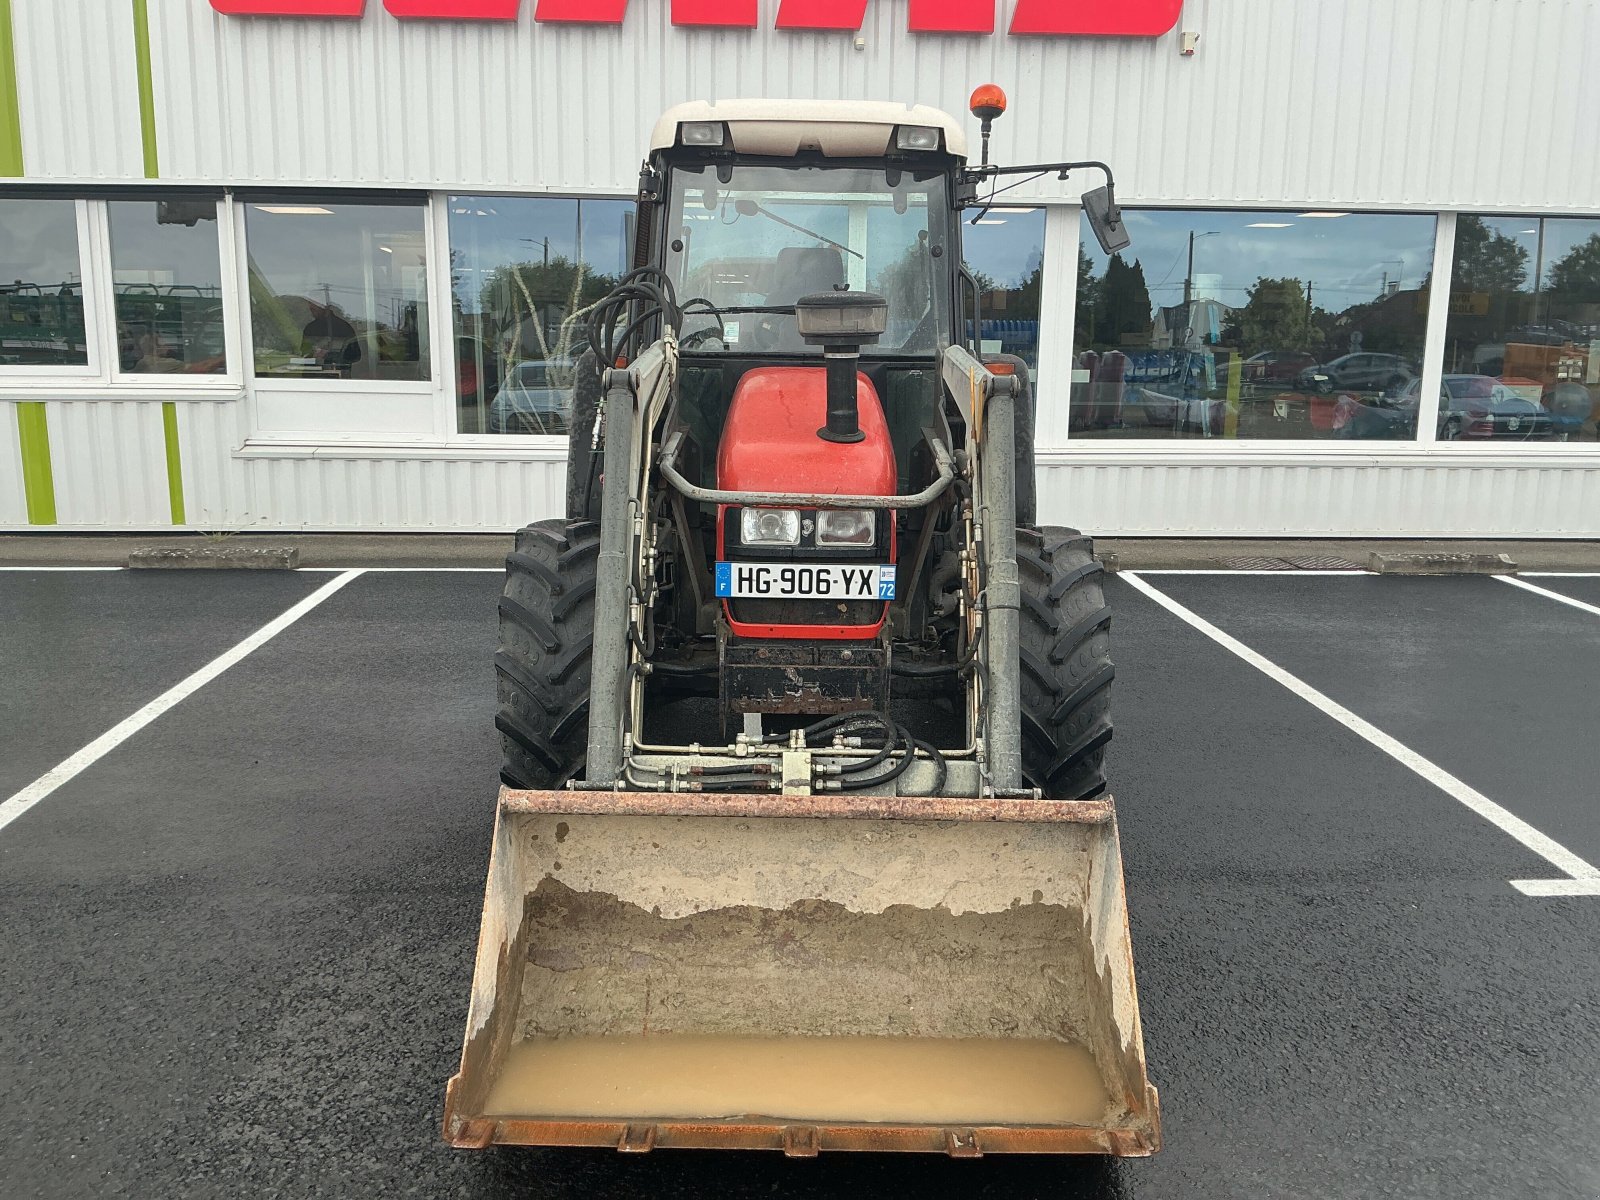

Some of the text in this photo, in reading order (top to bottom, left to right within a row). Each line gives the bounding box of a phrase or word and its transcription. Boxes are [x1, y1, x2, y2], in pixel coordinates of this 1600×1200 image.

[720, 583, 726, 591] F
[738, 567, 873, 595] HG-906-YX
[880, 583, 894, 596] 72
